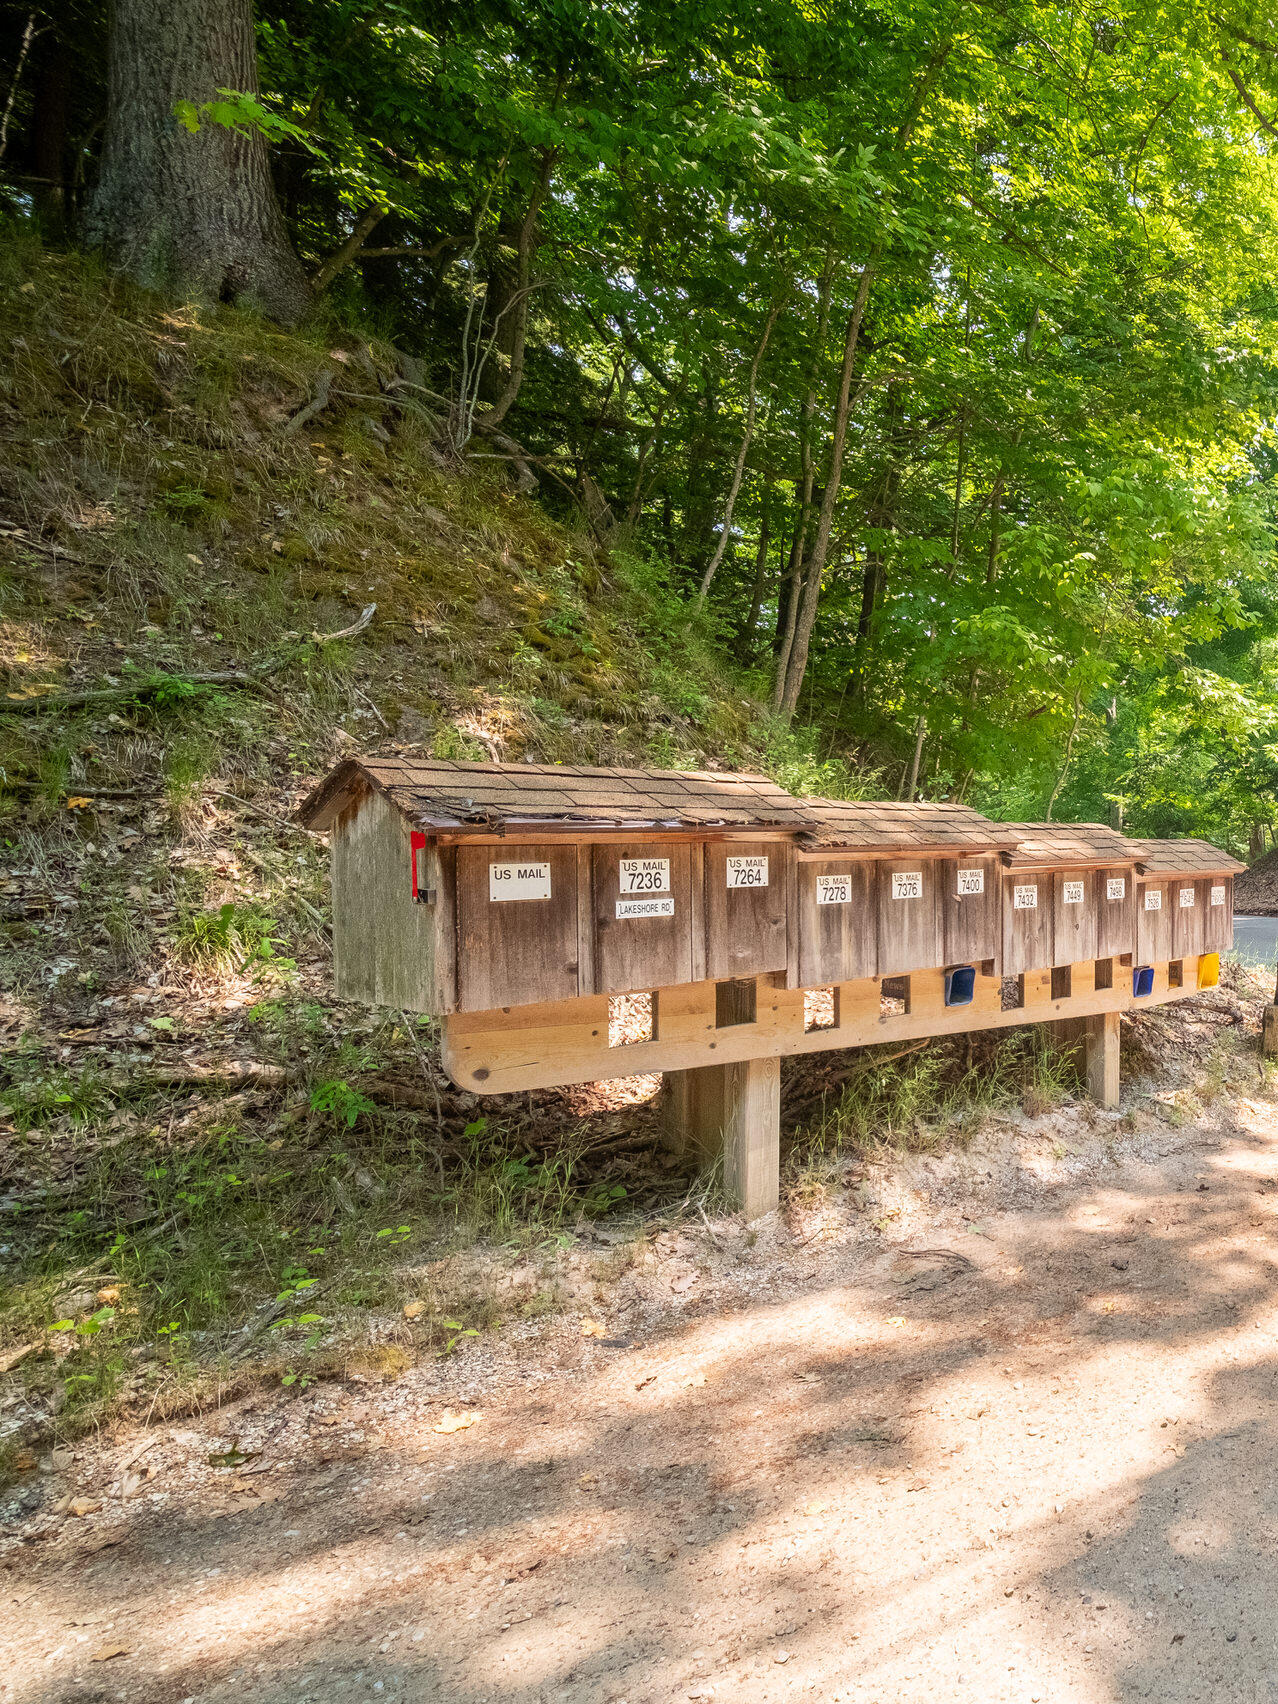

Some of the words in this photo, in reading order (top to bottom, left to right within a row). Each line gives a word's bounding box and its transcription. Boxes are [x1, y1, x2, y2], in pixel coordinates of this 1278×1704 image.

[623, 861, 638, 871] US
[643, 861, 666, 870] MAIL
[728, 859, 742, 868] US
[746, 858, 765, 867] MAIL
[494, 869, 512, 880] US
[517, 868, 546, 879] MAIL
[733, 869, 762, 885] 7264
[894, 874, 904, 882] US
[906, 873, 919, 881] MAIL
[959, 871, 968, 879] US
[628, 871, 662, 890] 7236
[819, 877, 830, 886] US
[833, 877, 849, 885] MAIL
[962, 879, 980, 892] 7400
[822, 886, 847, 901] 7278
[897, 882, 918, 897] 7376
[1066, 889, 1081, 901] 7449
[1018, 894, 1034, 906] 7432
[619, 903, 659, 914] LAKESHORE
[661, 902, 670, 911] RD
